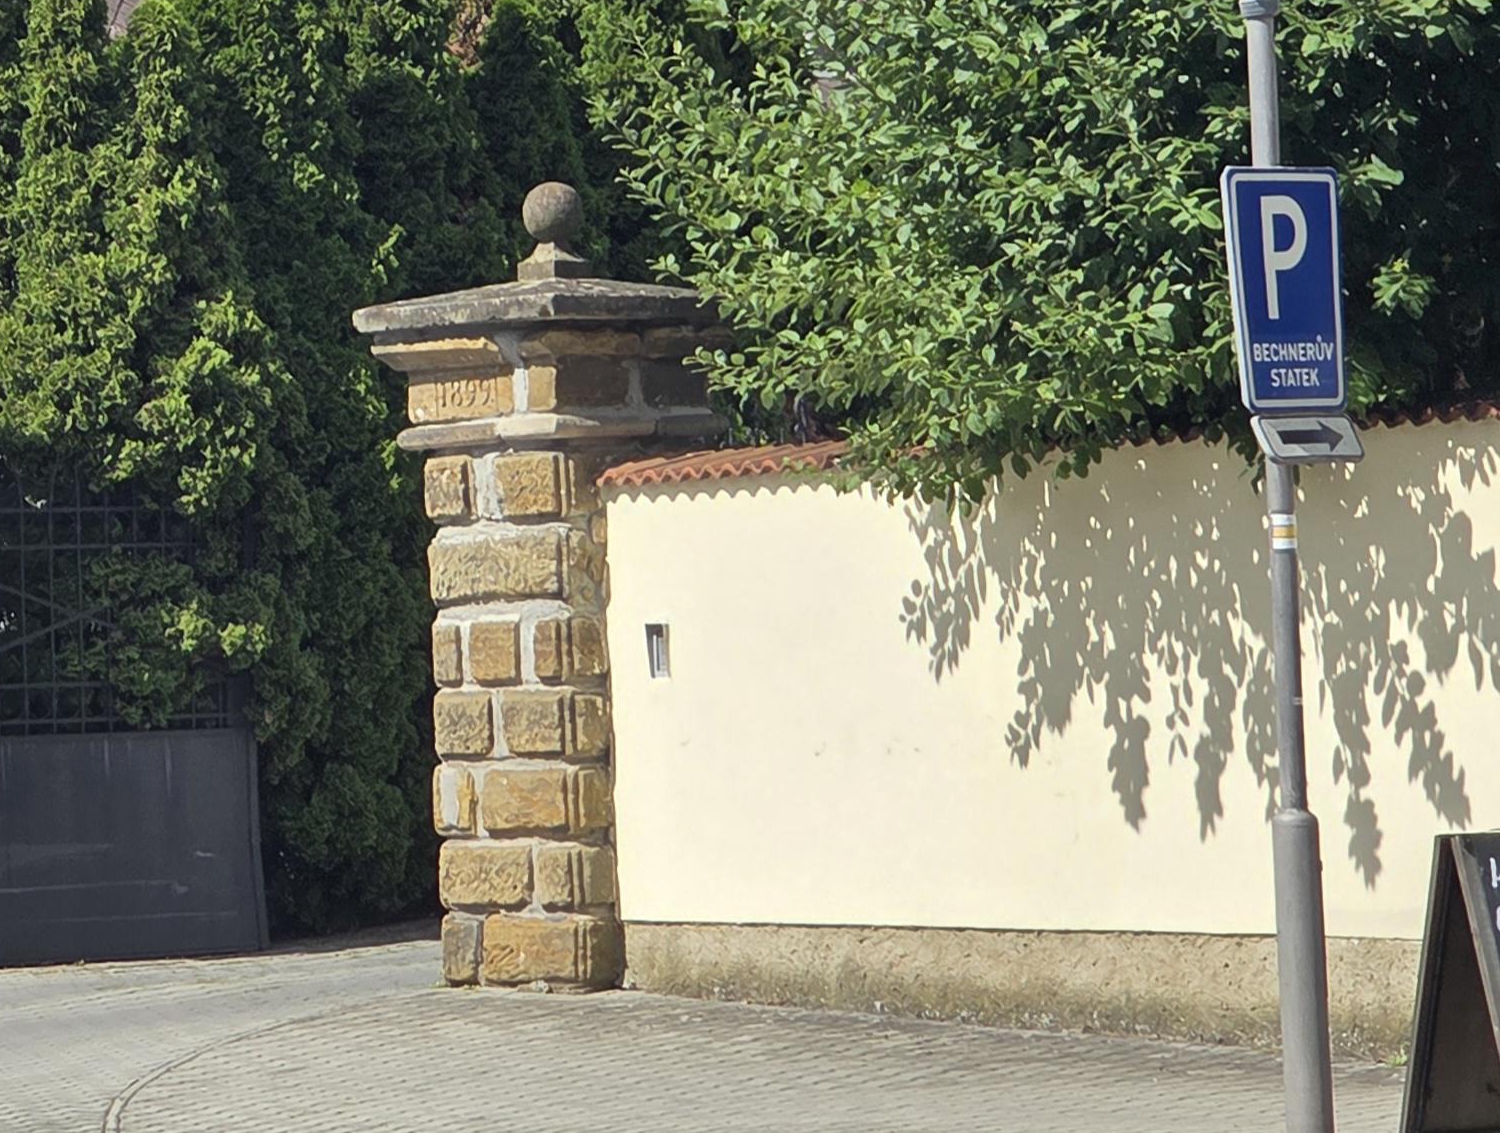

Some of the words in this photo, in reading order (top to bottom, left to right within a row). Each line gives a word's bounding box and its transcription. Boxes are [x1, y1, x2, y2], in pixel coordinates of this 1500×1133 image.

[1260, 195, 1308, 320] P
[1253, 334, 1334, 363] BECHNERŮV
[1270, 367, 1320, 388] STATEK
